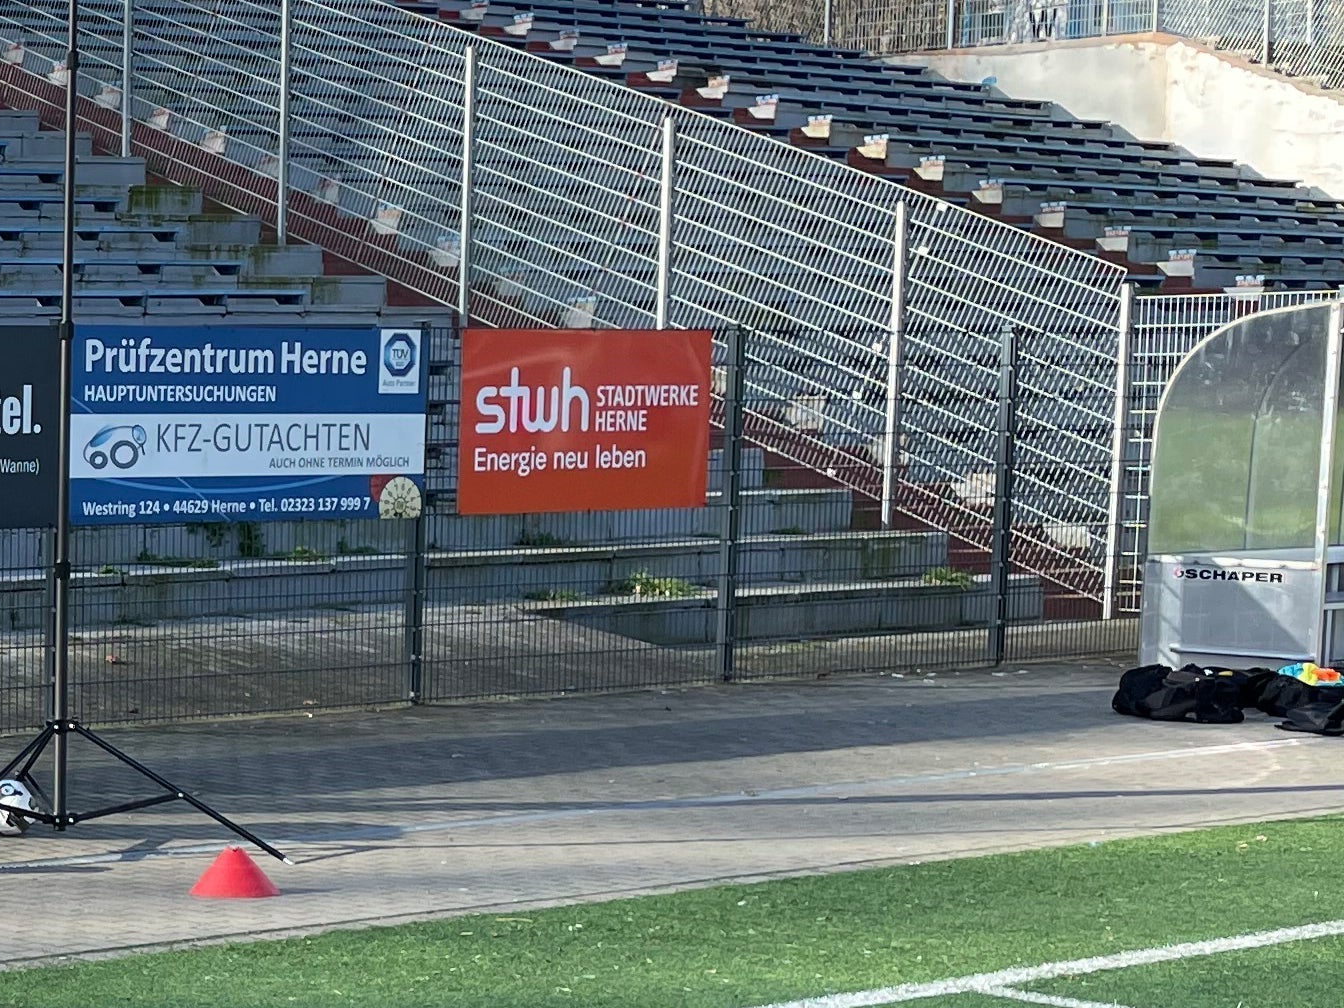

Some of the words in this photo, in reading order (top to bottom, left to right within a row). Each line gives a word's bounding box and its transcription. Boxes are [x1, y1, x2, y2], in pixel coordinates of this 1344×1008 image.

[84, 337, 274, 373] Prüfzentrum
[280, 341, 367, 374] Herne
[84, 385, 276, 402] HAUPTUNTERSUCHUNGEN
[475, 367, 589, 434] stwh
[596, 385, 698, 407] STADTWERKE
[595, 410, 647, 432] HERNE
[157, 422, 371, 453] KFZ-GUTACHTEN
[269, 457, 297, 469] AUCH
[299, 457, 325, 468] OHNE
[328, 457, 363, 467] TERMIN
[366, 455, 409, 468] MÖGLICH
[474, 446, 547, 477] Energie
[553, 450, 588, 470] neu
[595, 445, 646, 469] leben
[83, 500, 136, 518] Westring
[139, 501, 160, 515] 124
[173, 500, 208, 514] 44629
[212, 500, 246, 513] Herne
[259, 498, 278, 512] Tel.
[281, 499, 315, 512] 02323
[318, 498, 338, 511] 137
[340, 497, 360, 511] 999
[363, 497, 370, 510] 7
